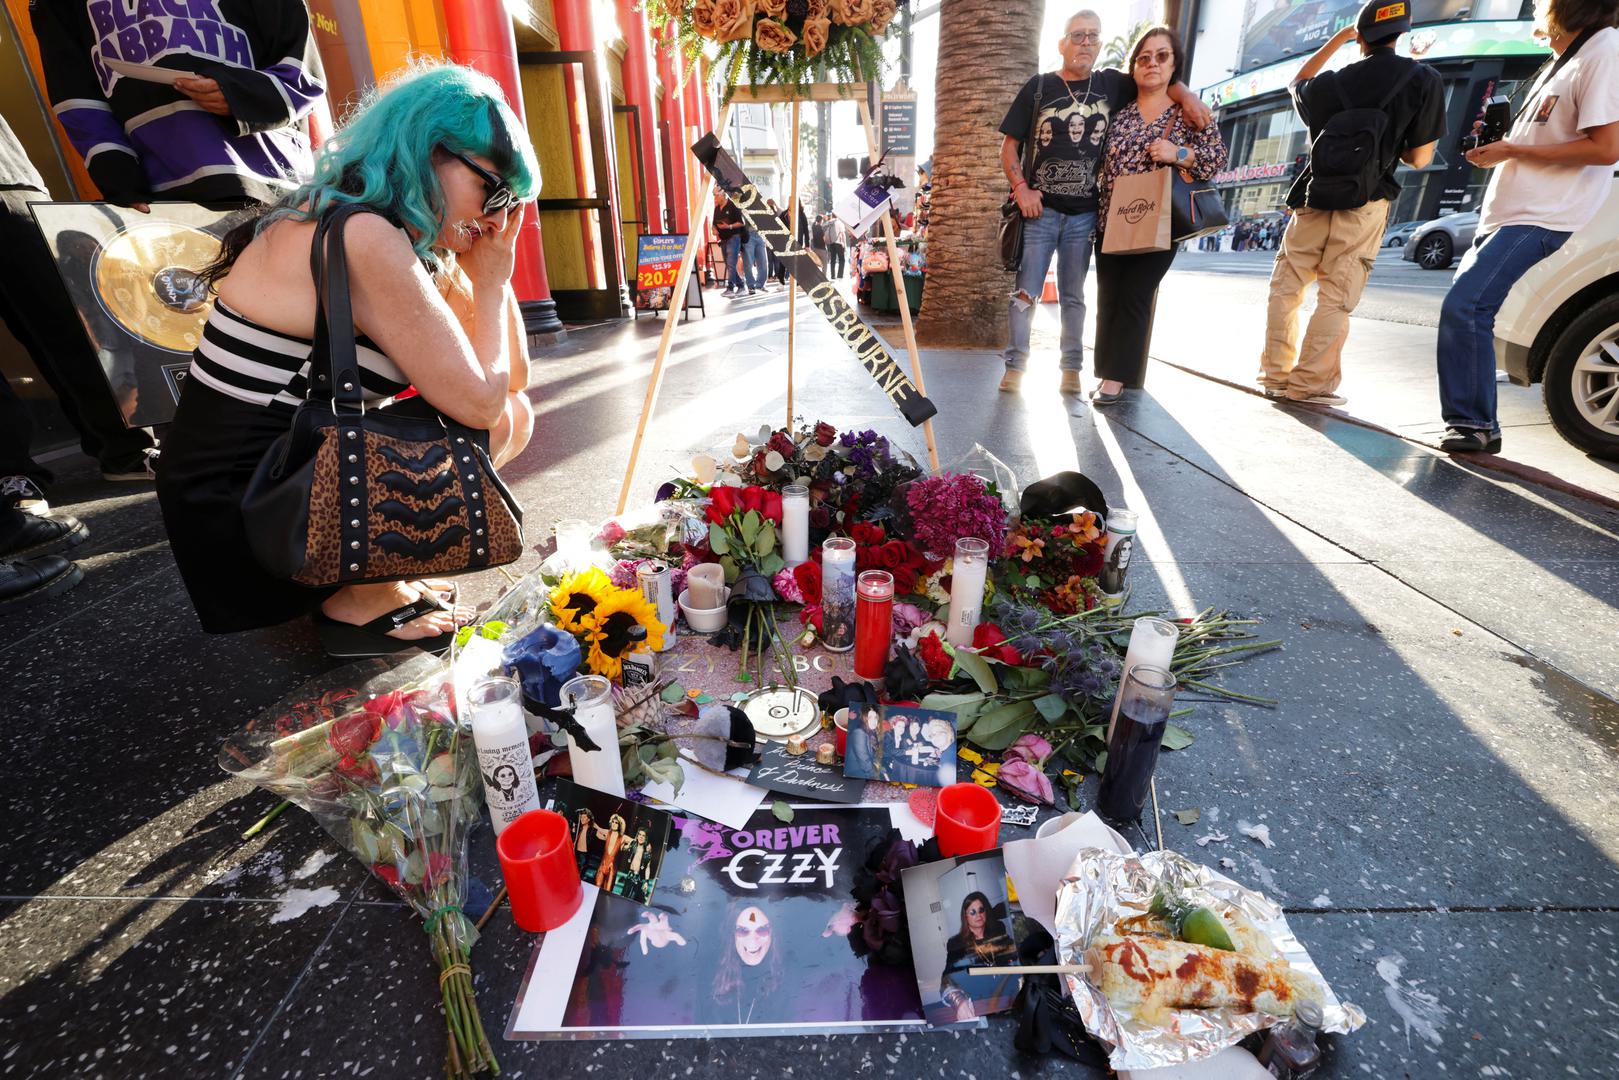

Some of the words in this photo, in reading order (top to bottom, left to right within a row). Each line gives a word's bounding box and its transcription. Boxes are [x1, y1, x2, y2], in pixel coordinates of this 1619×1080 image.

[316, 12, 338, 36] Not!
[1333, 15, 1357, 33] hu
[1303, 30, 1320, 42] AUG
[91, 17, 253, 95] SABBATH
[1241, 161, 1286, 181] Locker
[730, 183, 812, 258] OZZY
[1117, 205, 1137, 216] Hard
[1137, 202, 1156, 213] Rock
[638, 269, 679, 286] $20.7
[808, 281, 917, 408] OSBOURNE
[773, 769, 845, 792] Darkness
[720, 847, 843, 889] OZZY
